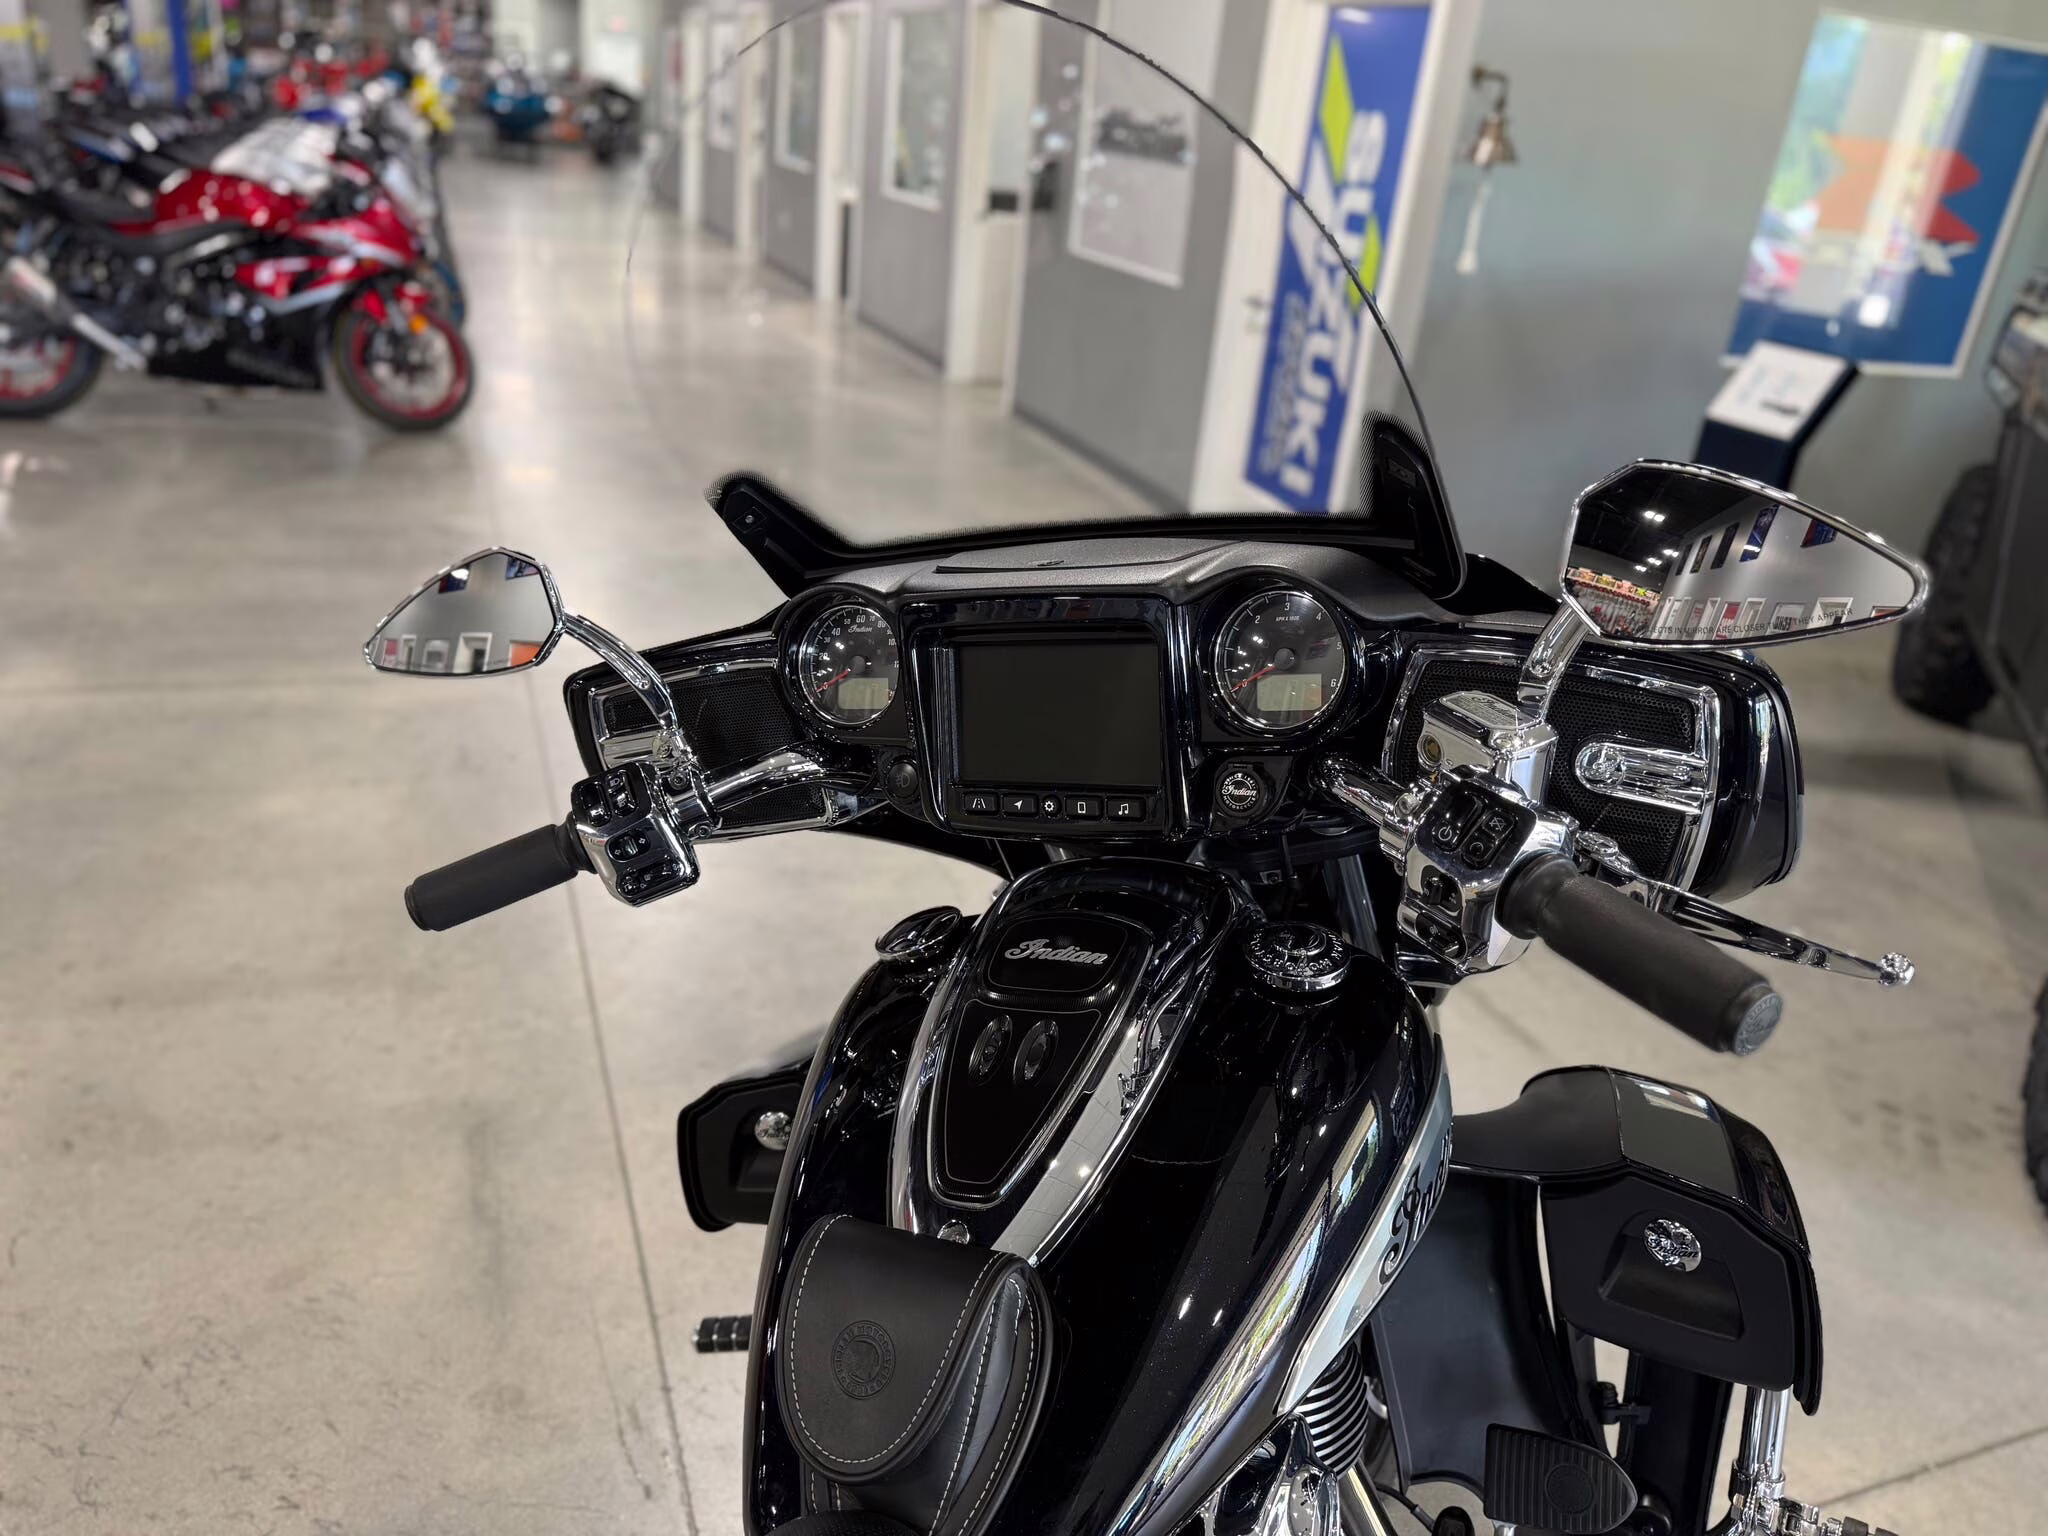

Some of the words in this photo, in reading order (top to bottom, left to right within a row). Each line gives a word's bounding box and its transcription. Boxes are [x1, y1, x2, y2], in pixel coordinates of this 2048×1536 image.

[1278, 110, 1387, 497] SUZUKI
[1284, 602, 1290, 611] 3
[856, 614, 866, 623] 60
[1254, 615, 1261, 624] 2
[1315, 612, 1322, 621] 4
[848, 624, 873, 633] Indian
[877, 620, 886, 628] 80
[1733, 623, 1766, 633] CLOSER
[831, 627, 841, 636] 40
[1336, 642, 1342, 651] 5
[1330, 678, 1337, 688] 6
[1222, 784, 1257, 797] Indian
[1004, 938, 1109, 965] Indian
